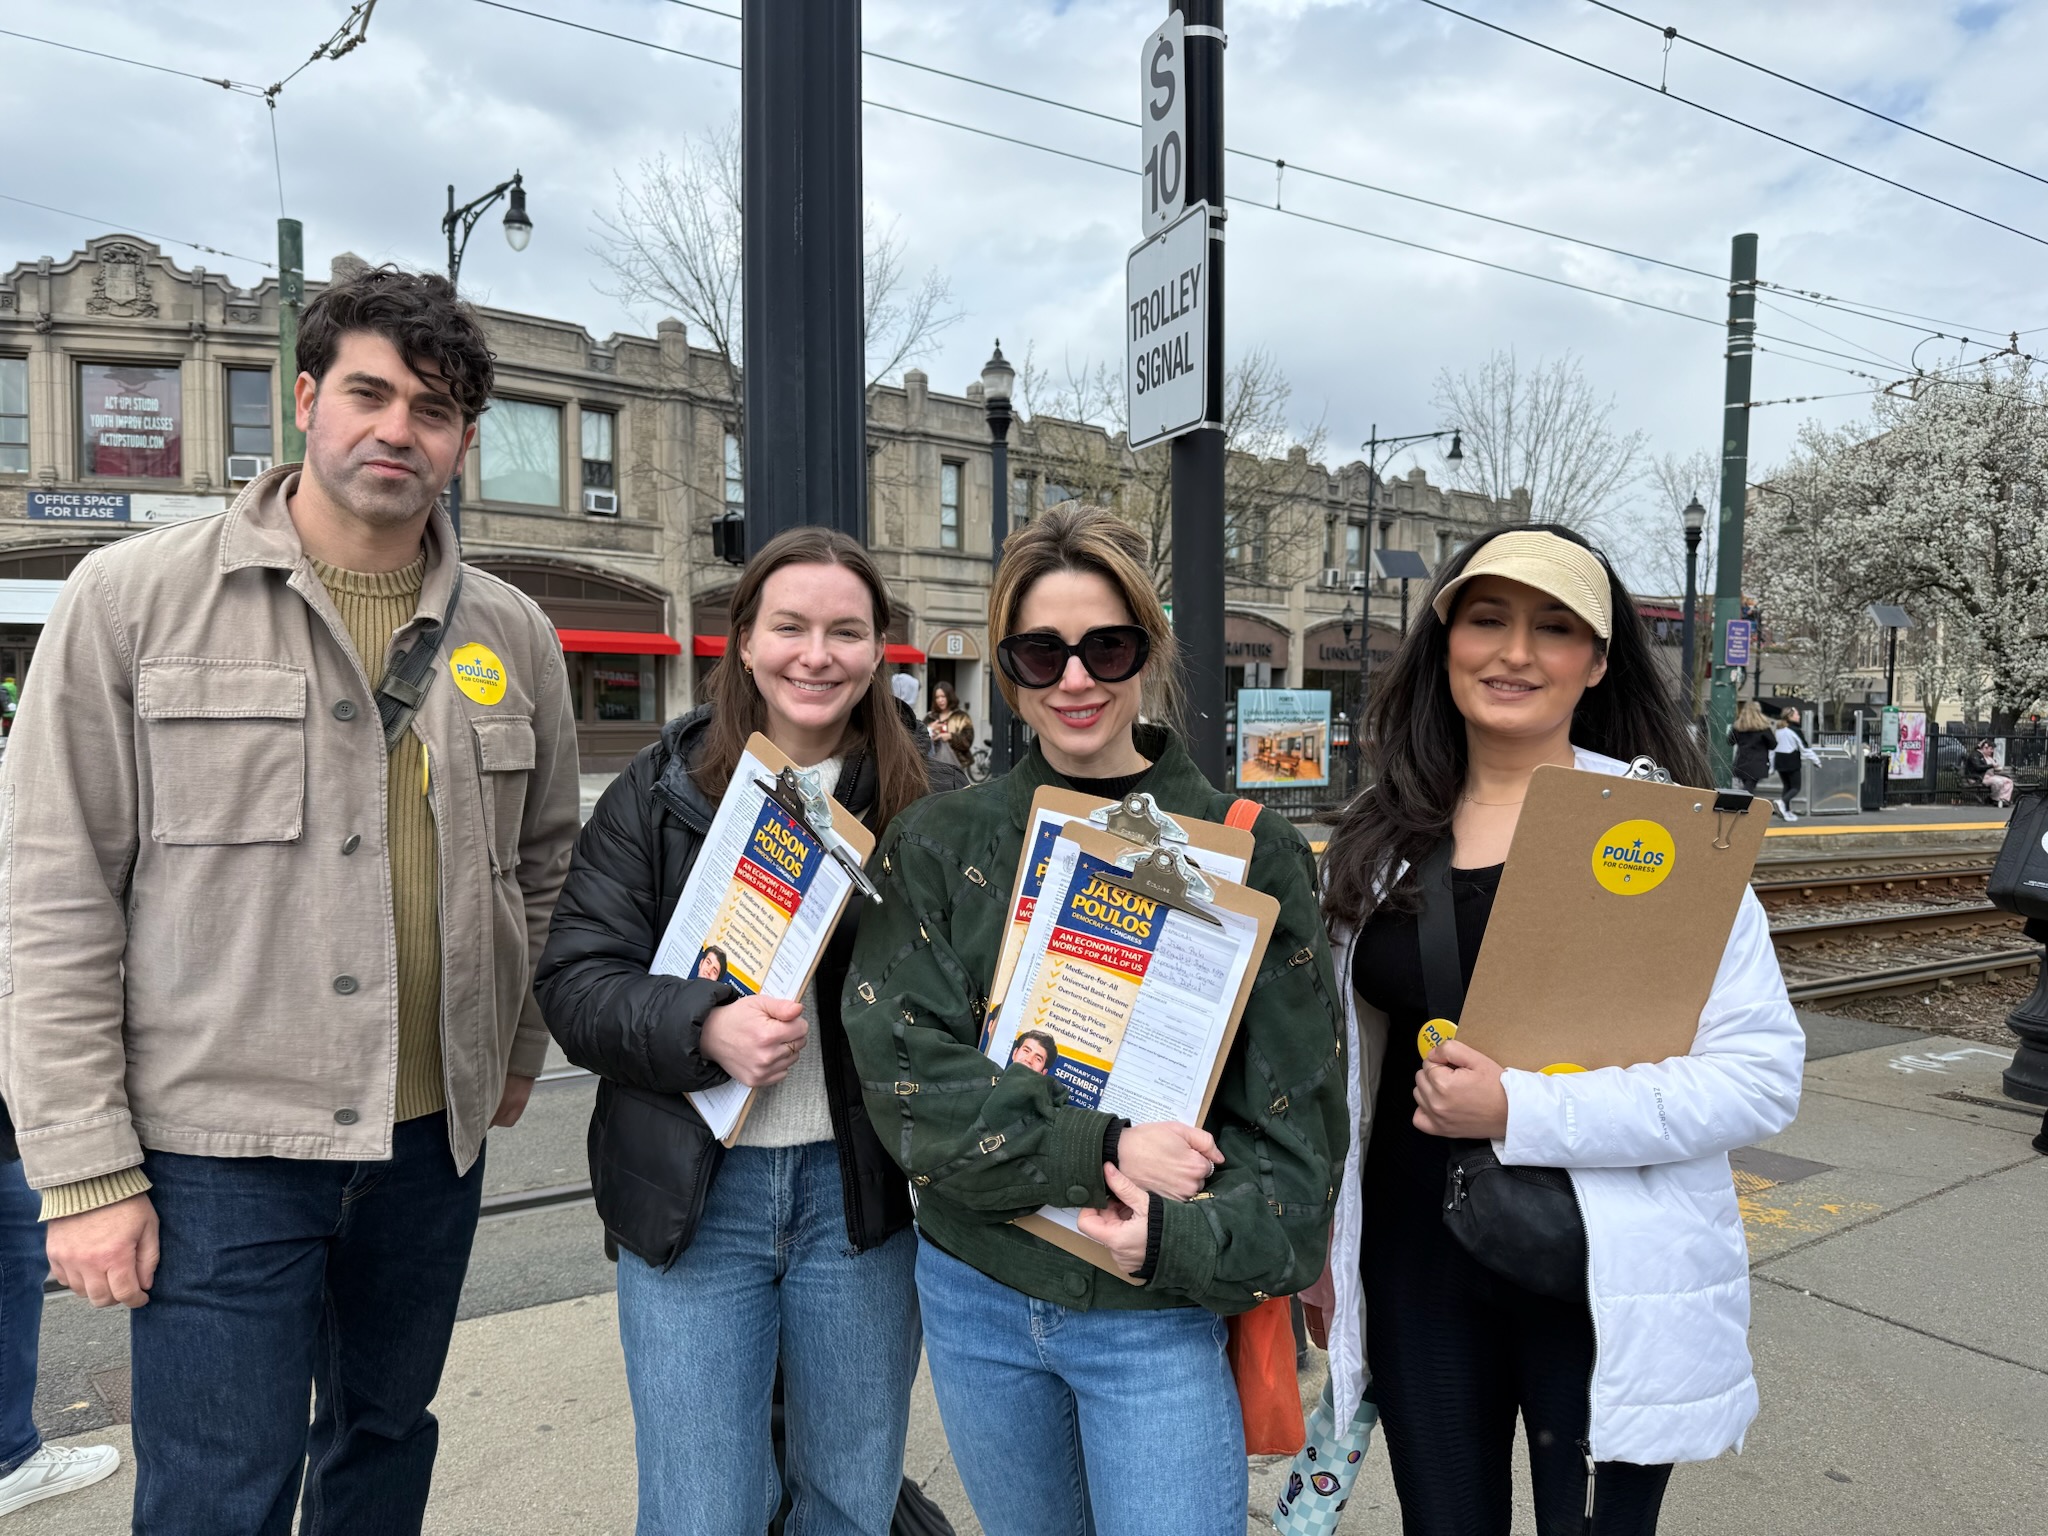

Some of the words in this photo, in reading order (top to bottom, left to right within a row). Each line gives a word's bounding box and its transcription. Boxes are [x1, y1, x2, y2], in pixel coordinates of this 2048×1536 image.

[1150, 40, 1175, 121] S
[1145, 130, 1181, 215] 10
[1131, 262, 1202, 342] TROLLEY
[1137, 332, 1194, 396] SIGNAL
[105, 396, 118, 410] ACT
[120, 397, 131, 410] UP!
[134, 398, 158, 411] STUDIO
[90, 414, 114, 428] YOUTH
[116, 416, 142, 429] IMPROV
[144, 417, 173, 431] CLASSES
[100, 433, 164, 448] ACTUPSTUDIO.COM
[35, 494, 80, 506] OFFICE
[84, 495, 124, 506] SPACE
[45, 507, 71, 517] FOR
[75, 508, 114, 518] LEASE
[456, 664, 500, 680] POULOS
[473, 678, 498, 686] CONGRESS
[754, 829, 803, 878] POULOS
[763, 818, 809, 862] JASON
[1603, 846, 1664, 866] POULOS
[1618, 863, 1655, 873] CONGRESS
[737, 867, 757, 885] WORKS
[756, 880, 766, 891] FOR
[766, 887, 778, 899] ALL
[784, 898, 792, 908] US
[743, 862, 752, 872] AN
[752, 867, 779, 888] ECONOMY
[780, 884, 794, 898] THAT
[1081, 878, 1159, 920] JASON
[1071, 894, 1152, 938] POULOS
[1072, 912, 1104, 929] DEMOCRAT
[1110, 928, 1142, 945] CONGRESS
[1052, 940, 1083, 954] WORKS
[1084, 950, 1100, 959] FOR
[1101, 954, 1118, 965] ALL
[1131, 962, 1143, 972] US
[1060, 933, 1073, 942] AN
[1075, 937, 1120, 954] ECONOMY
[1121, 950, 1143, 961] THAT
[1062, 975, 1090, 990] Universal
[1090, 988, 1106, 998] Basic
[1107, 994, 1128, 1008] Income
[1065, 964, 1118, 990] Medicare-for-All
[1053, 1000, 1071, 1013] Lower
[1072, 1009, 1087, 1021] Drug
[1088, 1016, 1106, 1028] Prices
[1058, 986, 1082, 1000] Overturn
[1083, 996, 1104, 1010] Citizens
[1105, 1006, 1123, 1019] United
[1045, 1022, 1076, 1039] Affordable
[1077, 1035, 1102, 1053] Housing
[1049, 1011, 1071, 1025] Expand
[1072, 1021, 1089, 1033] Social
[1089, 1029, 1113, 1044] Security
[1055, 1068, 1098, 1094] SEPTEMBER
[1064, 1062, 1090, 1078] PRIMARY
[1091, 1076, 1103, 1084] DAY
[1074, 1090, 1093, 1101] EARLY
